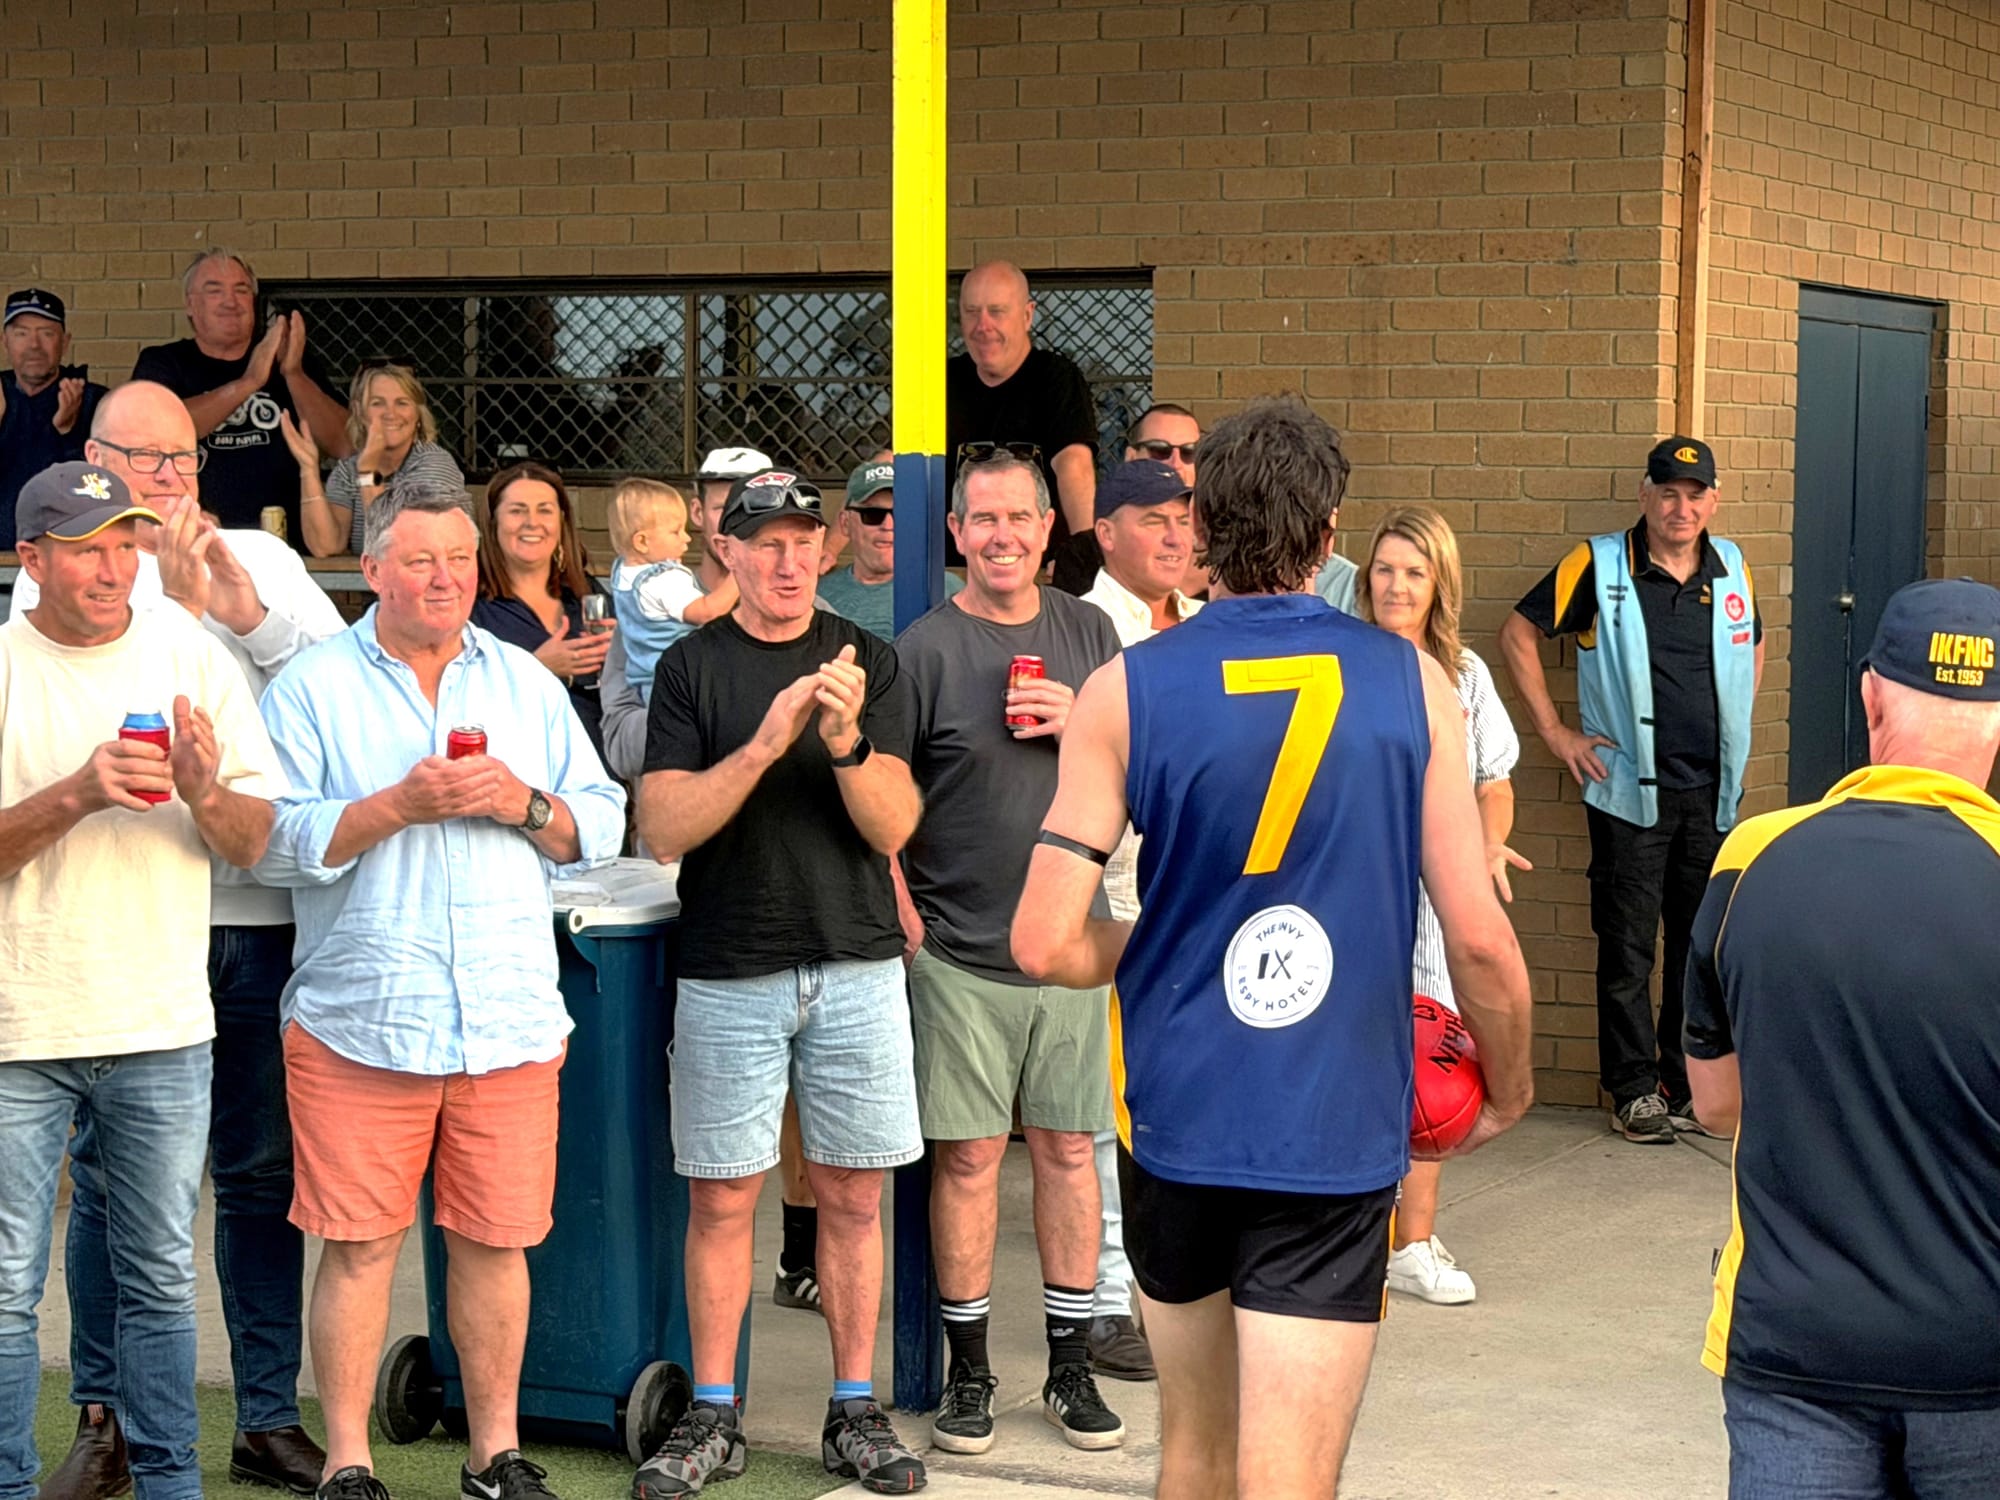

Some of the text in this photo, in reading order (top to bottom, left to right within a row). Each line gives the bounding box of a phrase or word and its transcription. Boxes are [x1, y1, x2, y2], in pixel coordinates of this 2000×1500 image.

[1929, 631, 1994, 668] IKFNC
[1935, 666, 1984, 686] Est. 1953
[1222, 654, 1344, 875] 7
[1265, 979, 1315, 1011] HOTEL
